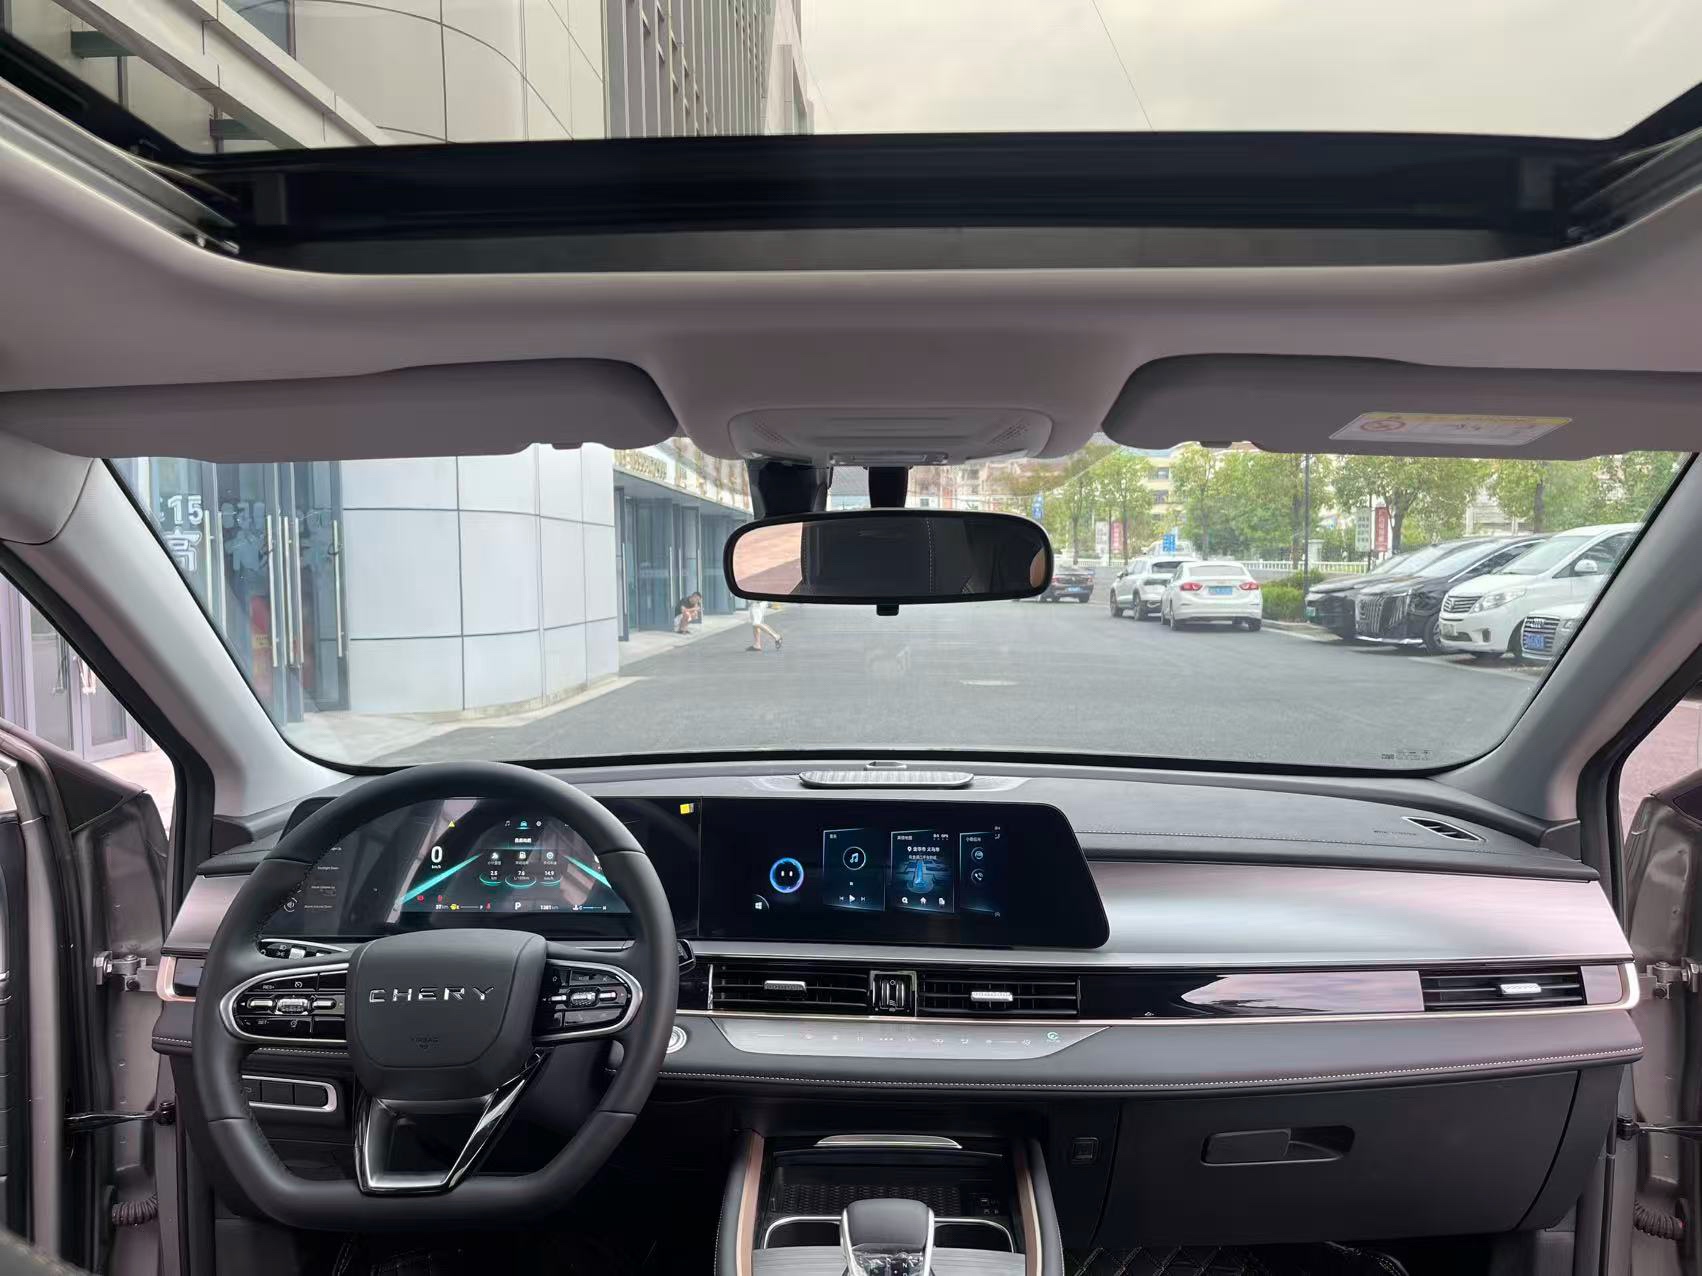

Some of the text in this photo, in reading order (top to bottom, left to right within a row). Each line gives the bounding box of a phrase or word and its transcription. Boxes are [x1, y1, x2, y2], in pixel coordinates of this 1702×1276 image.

[431, 846, 443, 863] 0
[515, 902, 522, 910] P
[368, 986, 495, 1003] CHERY
